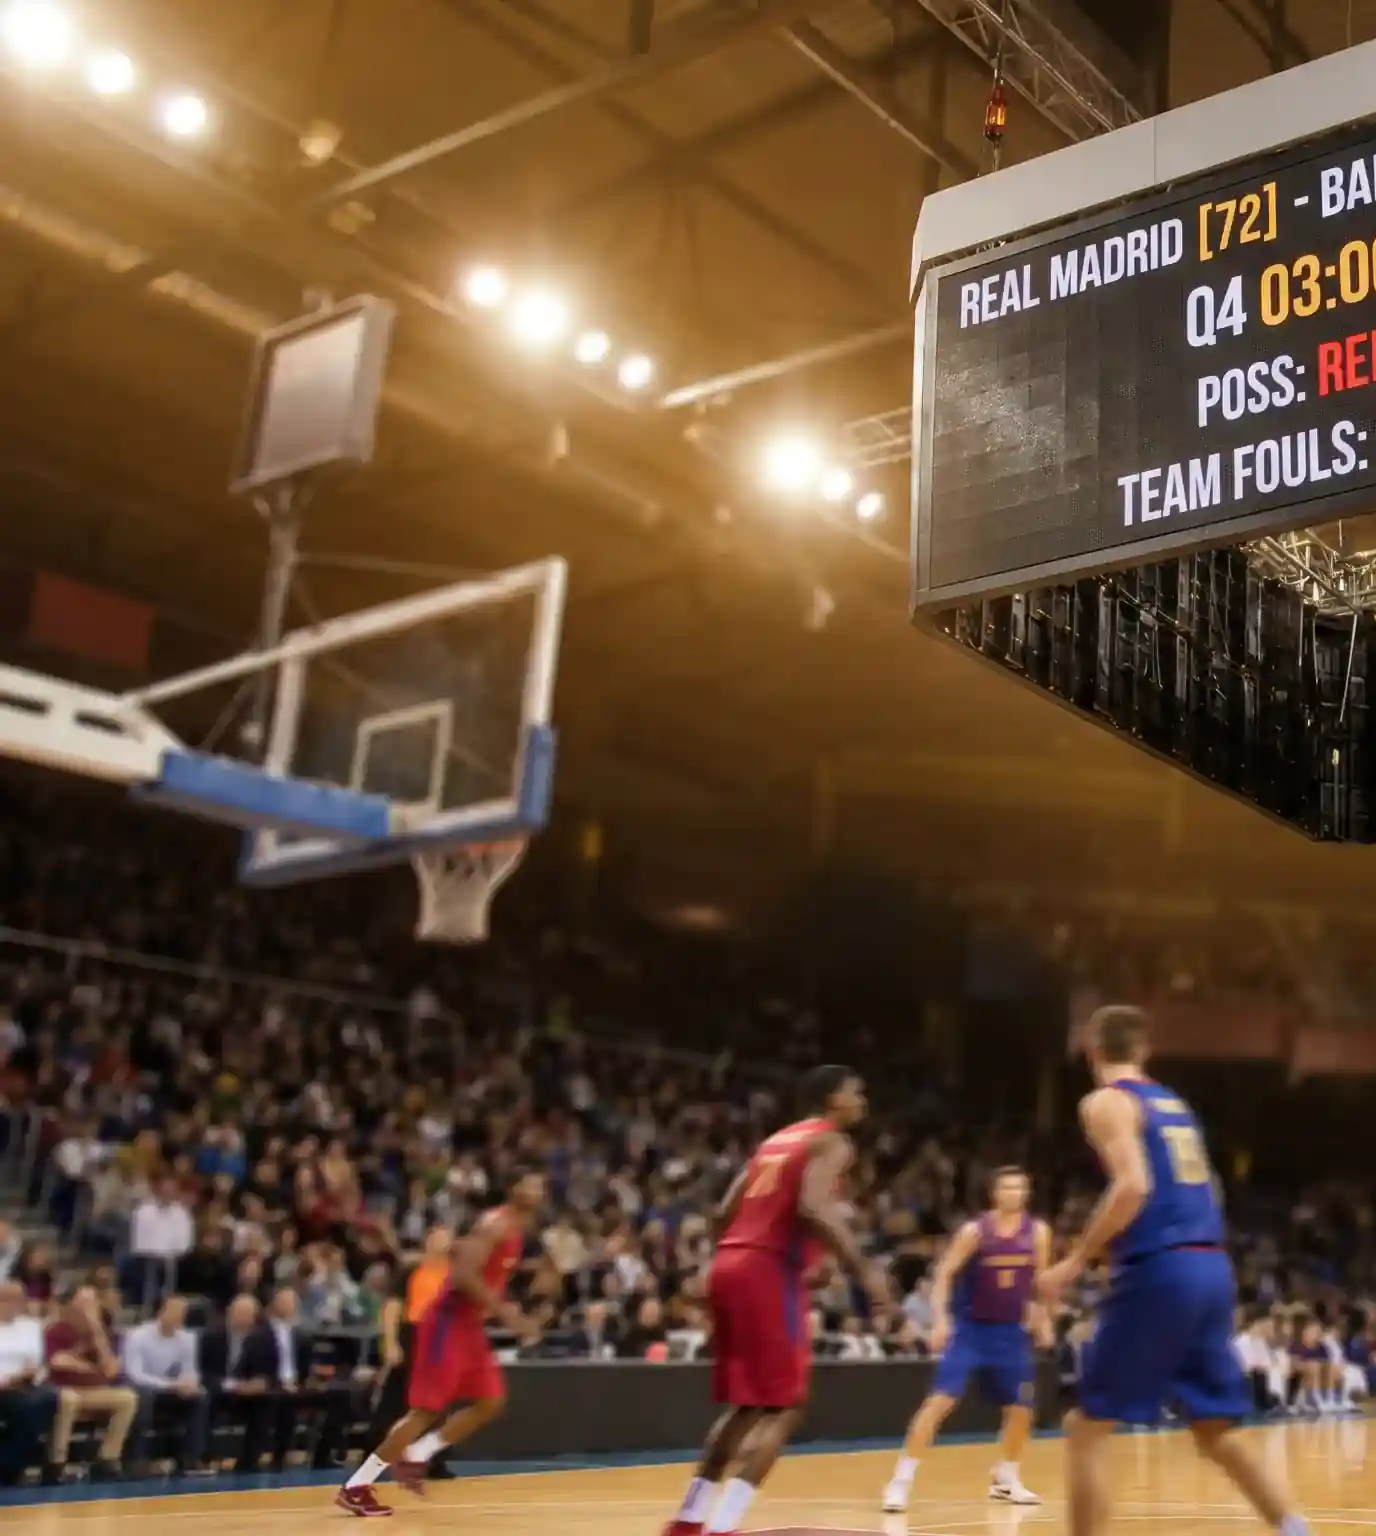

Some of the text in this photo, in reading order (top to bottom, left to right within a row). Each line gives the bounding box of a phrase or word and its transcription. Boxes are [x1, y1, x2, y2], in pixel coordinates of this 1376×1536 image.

[960, 264, 1041, 329] REAL
[1050, 218, 1184, 300] MADRID
[1199, 182, 1278, 262] [72]
[1294, 195, 1310, 207] -
[1186, 275, 1248, 348] Q4
[1197, 354, 1306, 428] POSS:
[1117, 452, 1221, 527] TEAM
[1233, 420, 1368, 501] FOULS:
